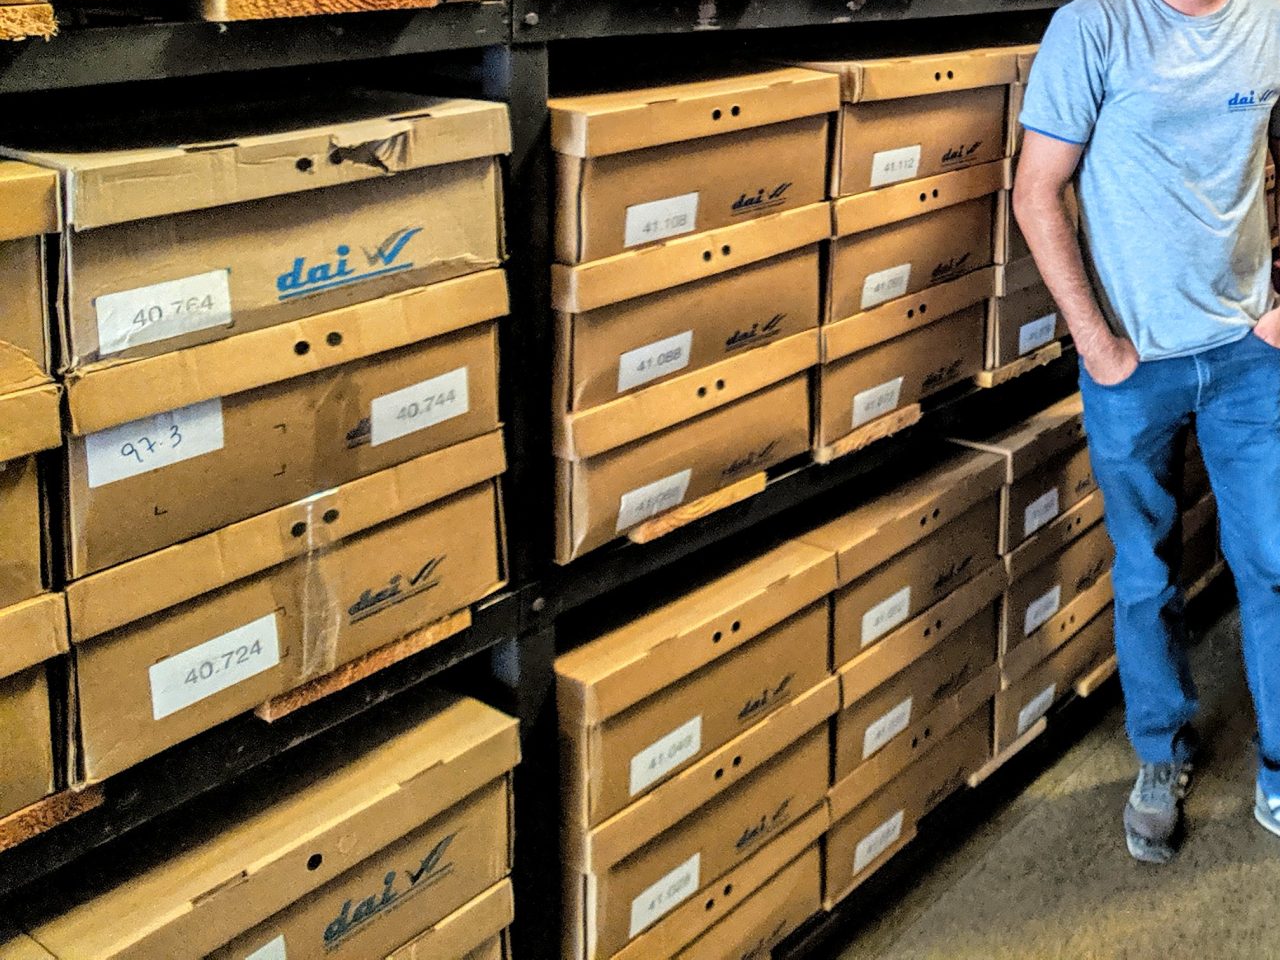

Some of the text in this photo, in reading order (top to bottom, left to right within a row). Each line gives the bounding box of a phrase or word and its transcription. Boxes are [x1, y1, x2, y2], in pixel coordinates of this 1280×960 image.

[1228, 90, 1255, 106] dai
[941, 145, 964, 164] dai
[730, 189, 764, 210] dai
[276, 245, 356, 293] dai
[132, 294, 214, 327] 40.764
[396, 390, 456, 423] 40.744
[120, 425, 182, 464] 97.3
[348, 575, 400, 616] dai
[184, 639, 263, 686] 40.724
[324, 870, 397, 945] dai
